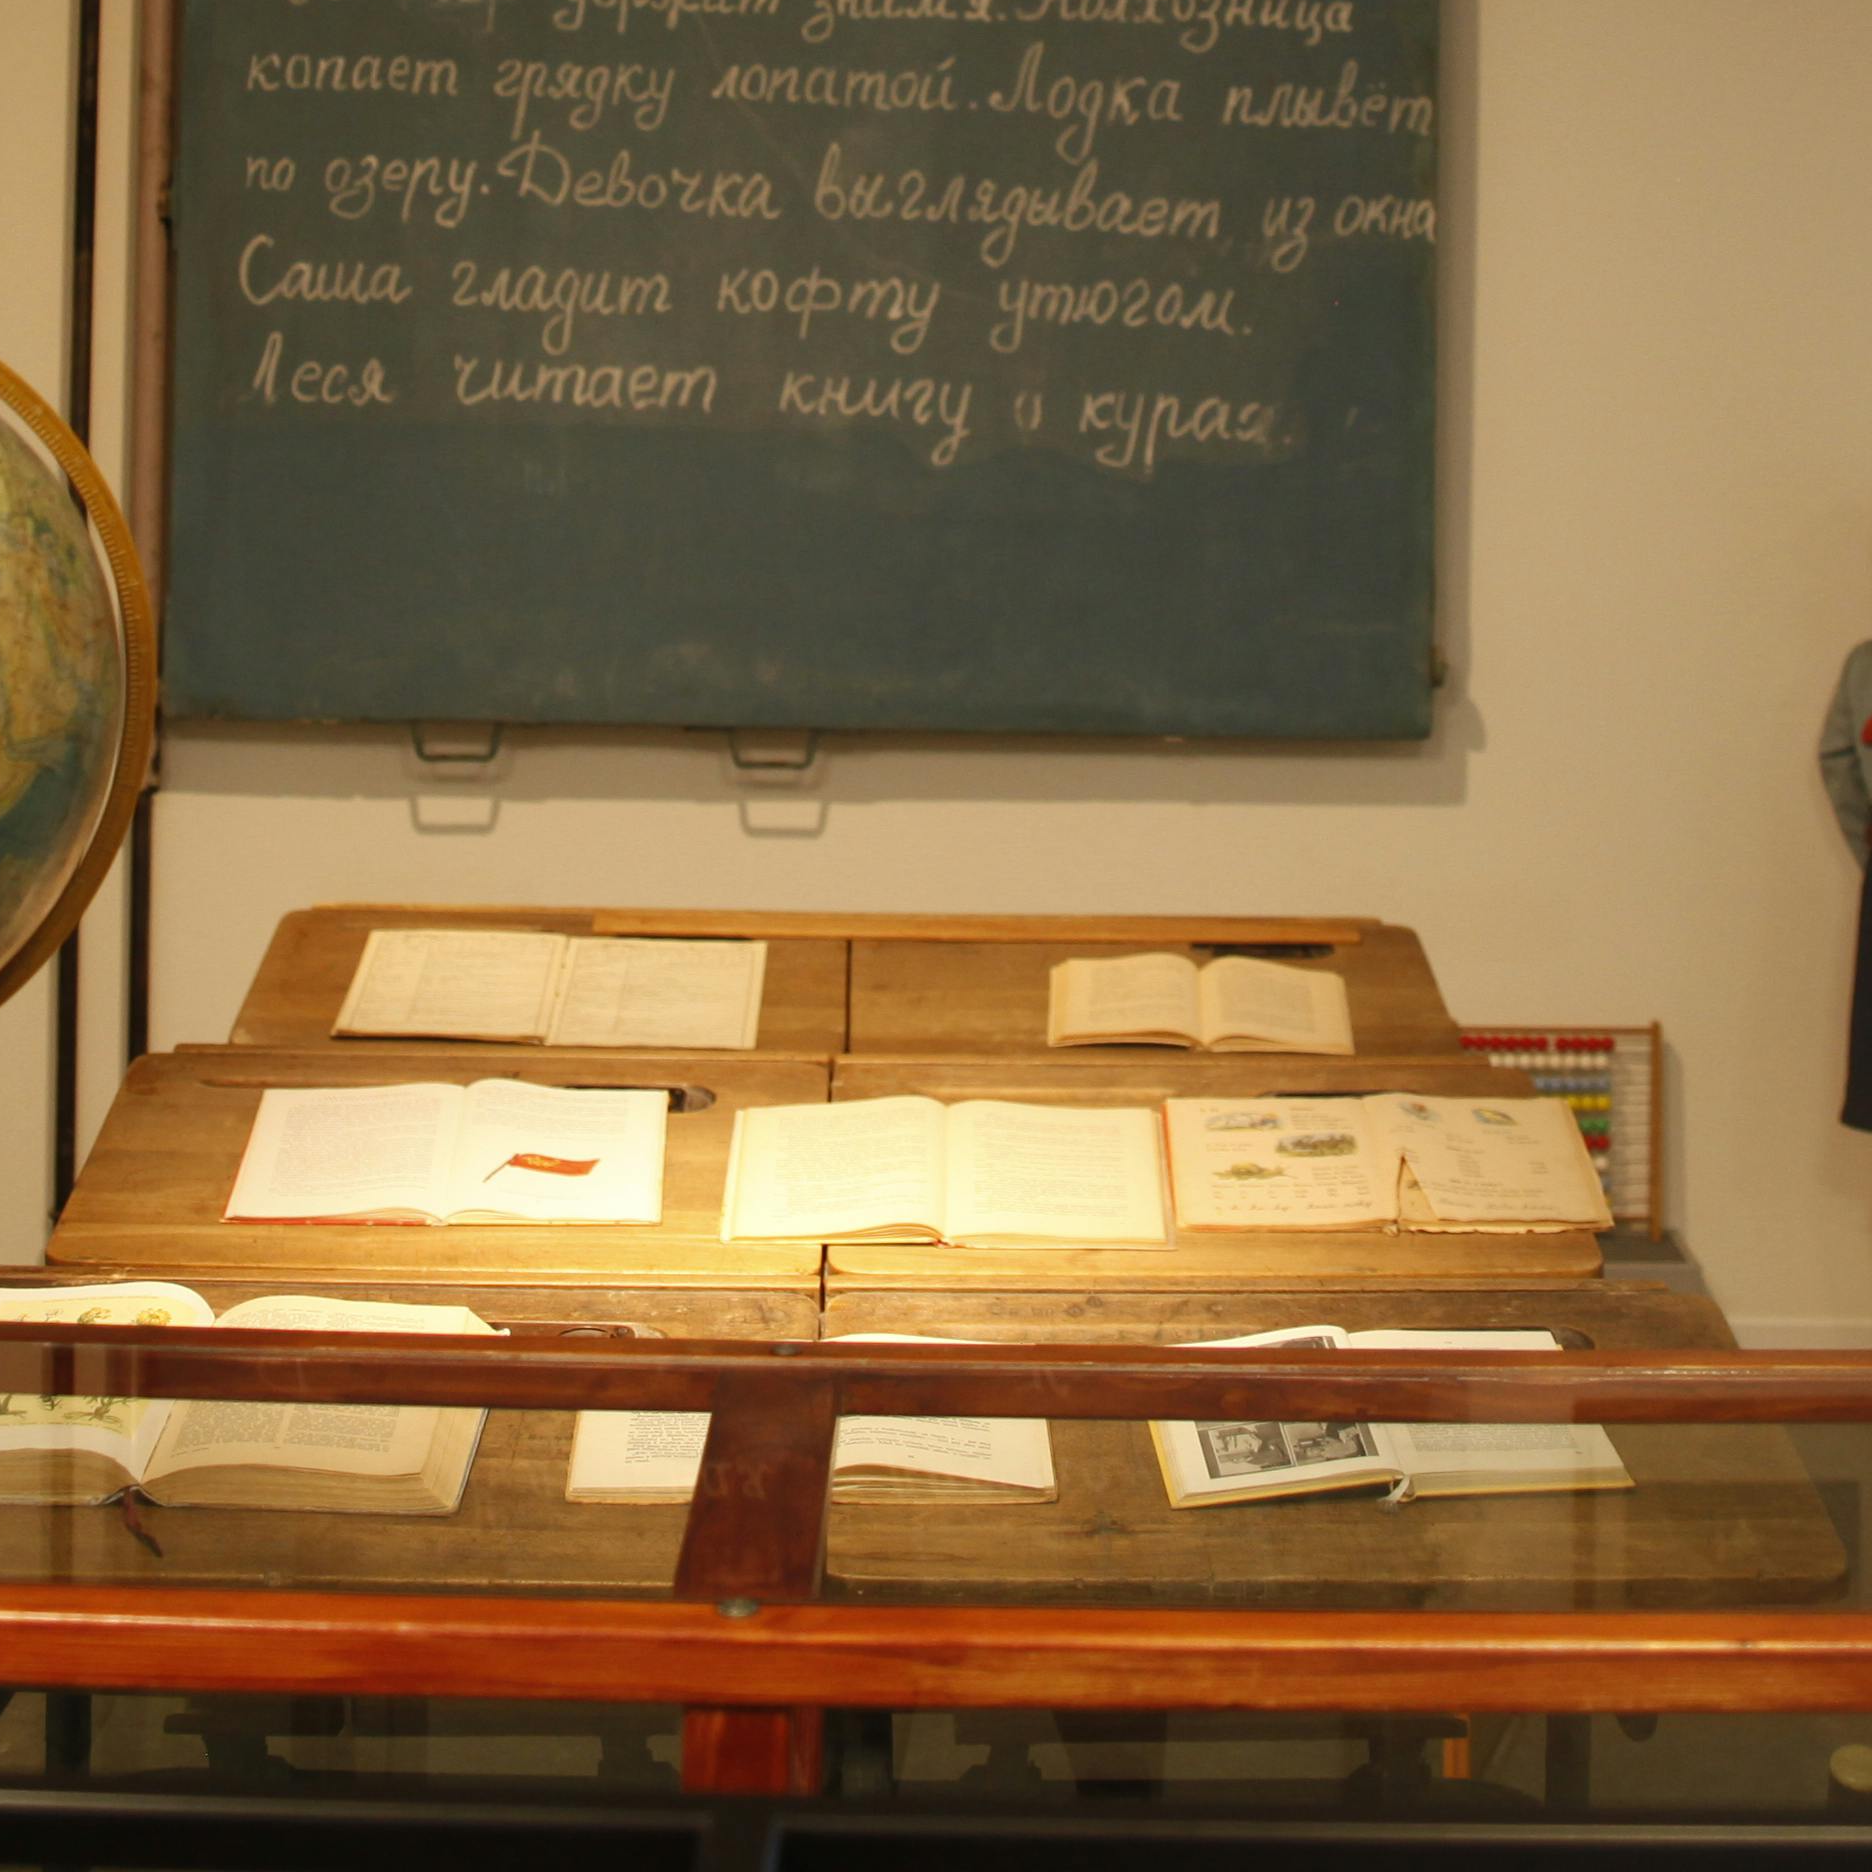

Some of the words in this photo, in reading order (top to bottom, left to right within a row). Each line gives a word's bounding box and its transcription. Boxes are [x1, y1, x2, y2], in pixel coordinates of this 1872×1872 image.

[246, 52, 460, 97] копает
[493, 57, 676, 142] грядку
[711, 57, 978, 112] лопатой.
[988, 41, 1184, 166] Лодка
[244, 154, 296, 191] по
[324, 154, 489, 228] озеру.
[497, 130, 783, 221] Девочка
[813, 142, 1222, 270] выглядывает
[1261, 196, 1316, 274] из
[1333, 193, 1437, 243] окна
[238, 233, 413, 305] Саша
[450, 260, 673, 356] гладит
[716, 265, 941, 355] кофту
[988, 278, 1253, 354] утюгом.
[250, 331, 393, 405] Леся
[454, 353, 718, 414] читает
[777, 371, 973, 467] книгу
